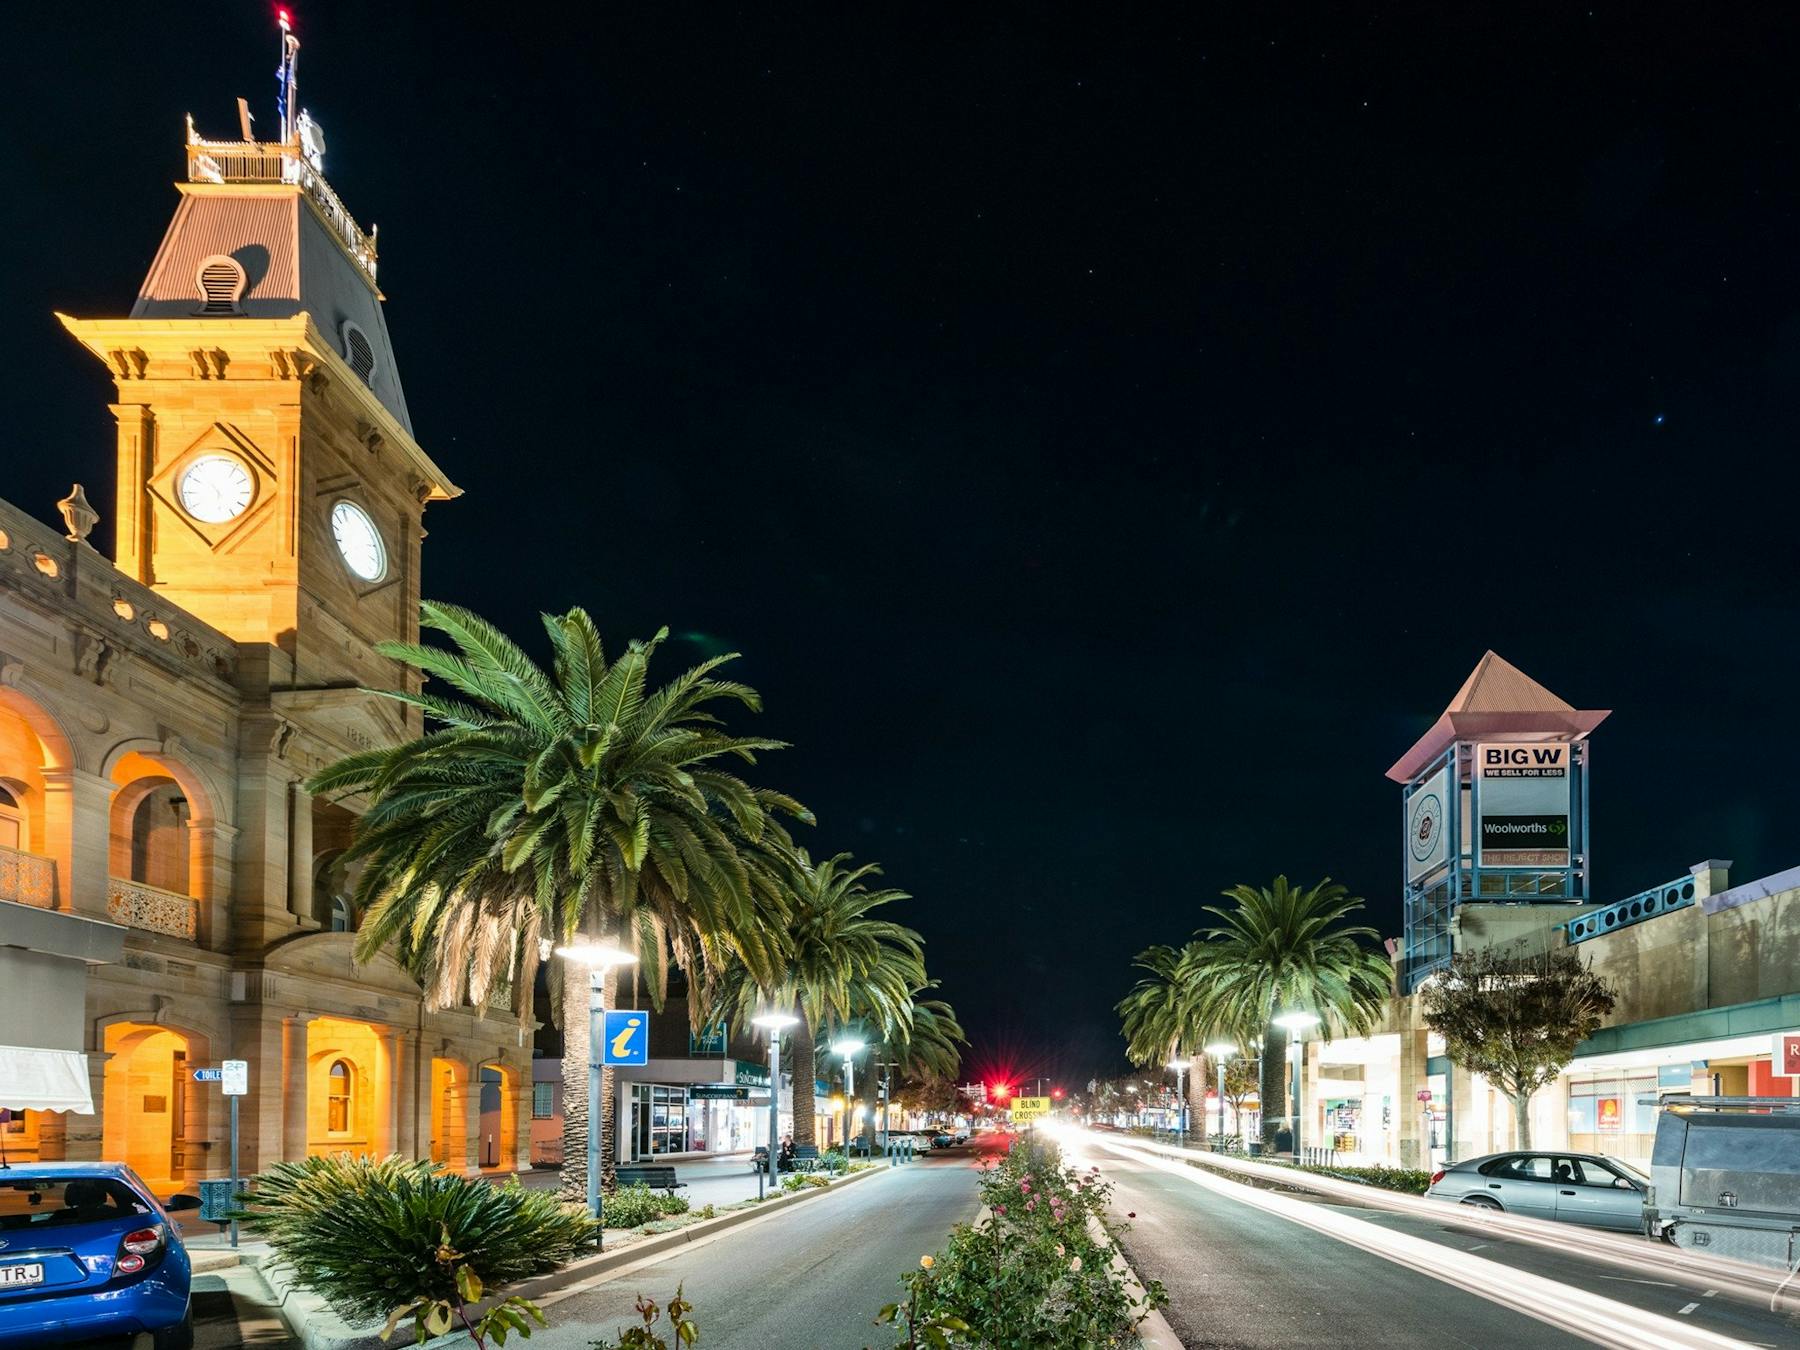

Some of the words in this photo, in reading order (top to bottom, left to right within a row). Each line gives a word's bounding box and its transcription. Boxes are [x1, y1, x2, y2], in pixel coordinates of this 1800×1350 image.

[1486, 748, 1529, 765] BIG
[1532, 748, 1562, 764] W
[1484, 822, 1547, 834] Woolworths
[1482, 854, 1500, 862] THE
[1503, 854, 1539, 862] REJECT
[1020, 1100, 1041, 1109] BLIND
